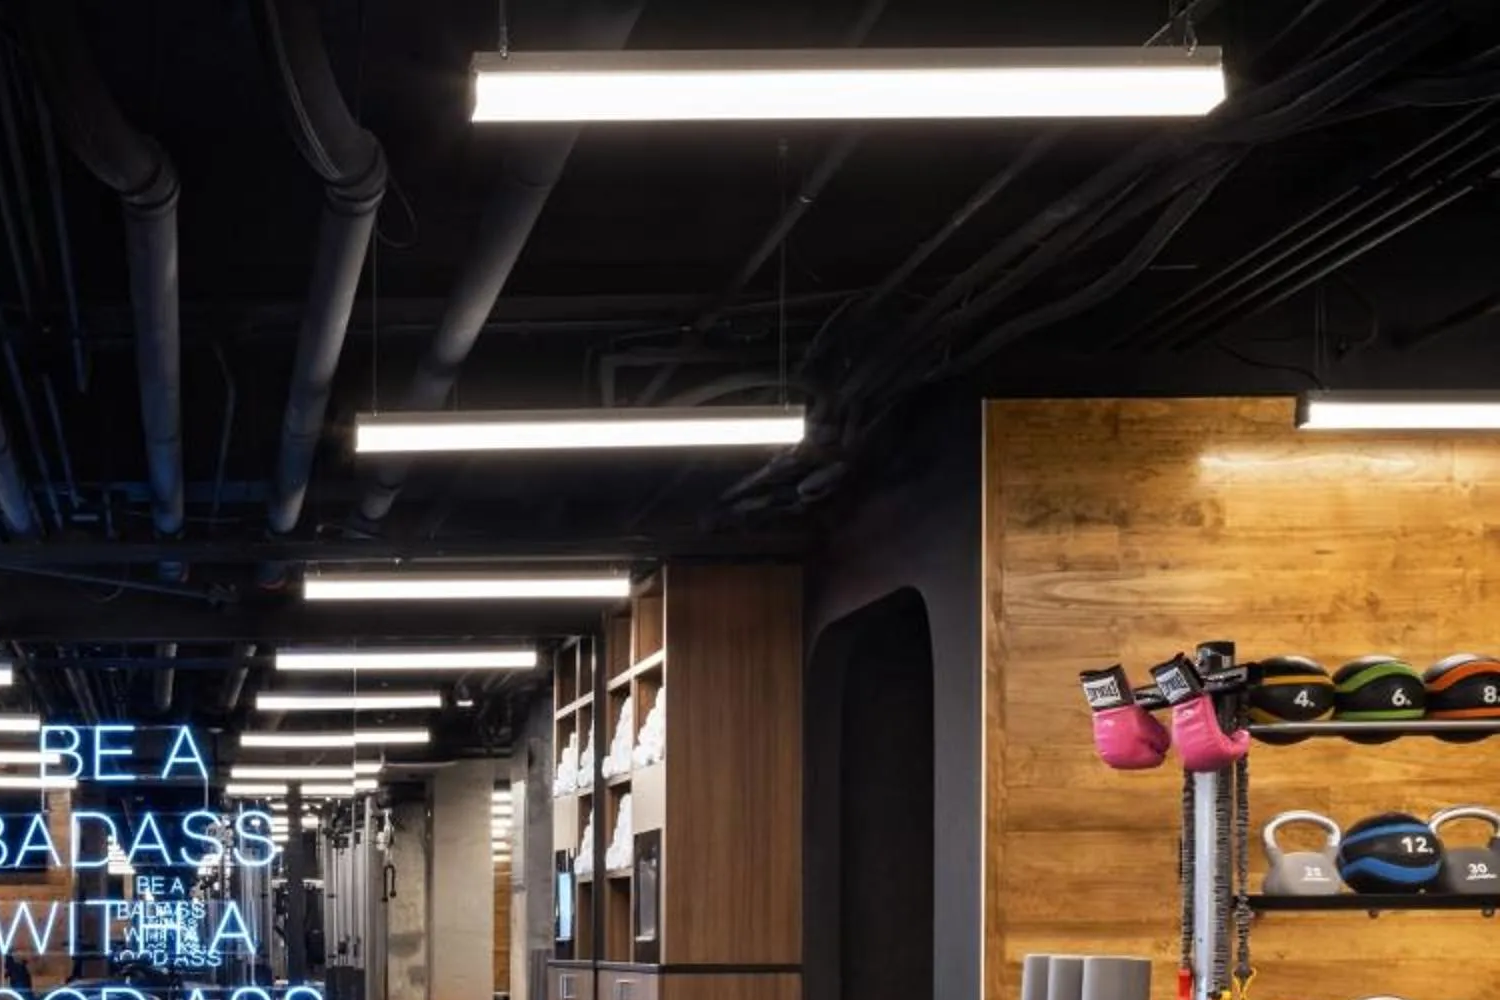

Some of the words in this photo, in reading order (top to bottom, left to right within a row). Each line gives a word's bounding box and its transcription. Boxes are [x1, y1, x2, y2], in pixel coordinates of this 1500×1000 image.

[40, 724, 136, 781] BE
[161, 724, 209, 781] A
[136, 876, 165, 896] BE
[170, 877, 185, 895] A
[205, 900, 257, 957] A
